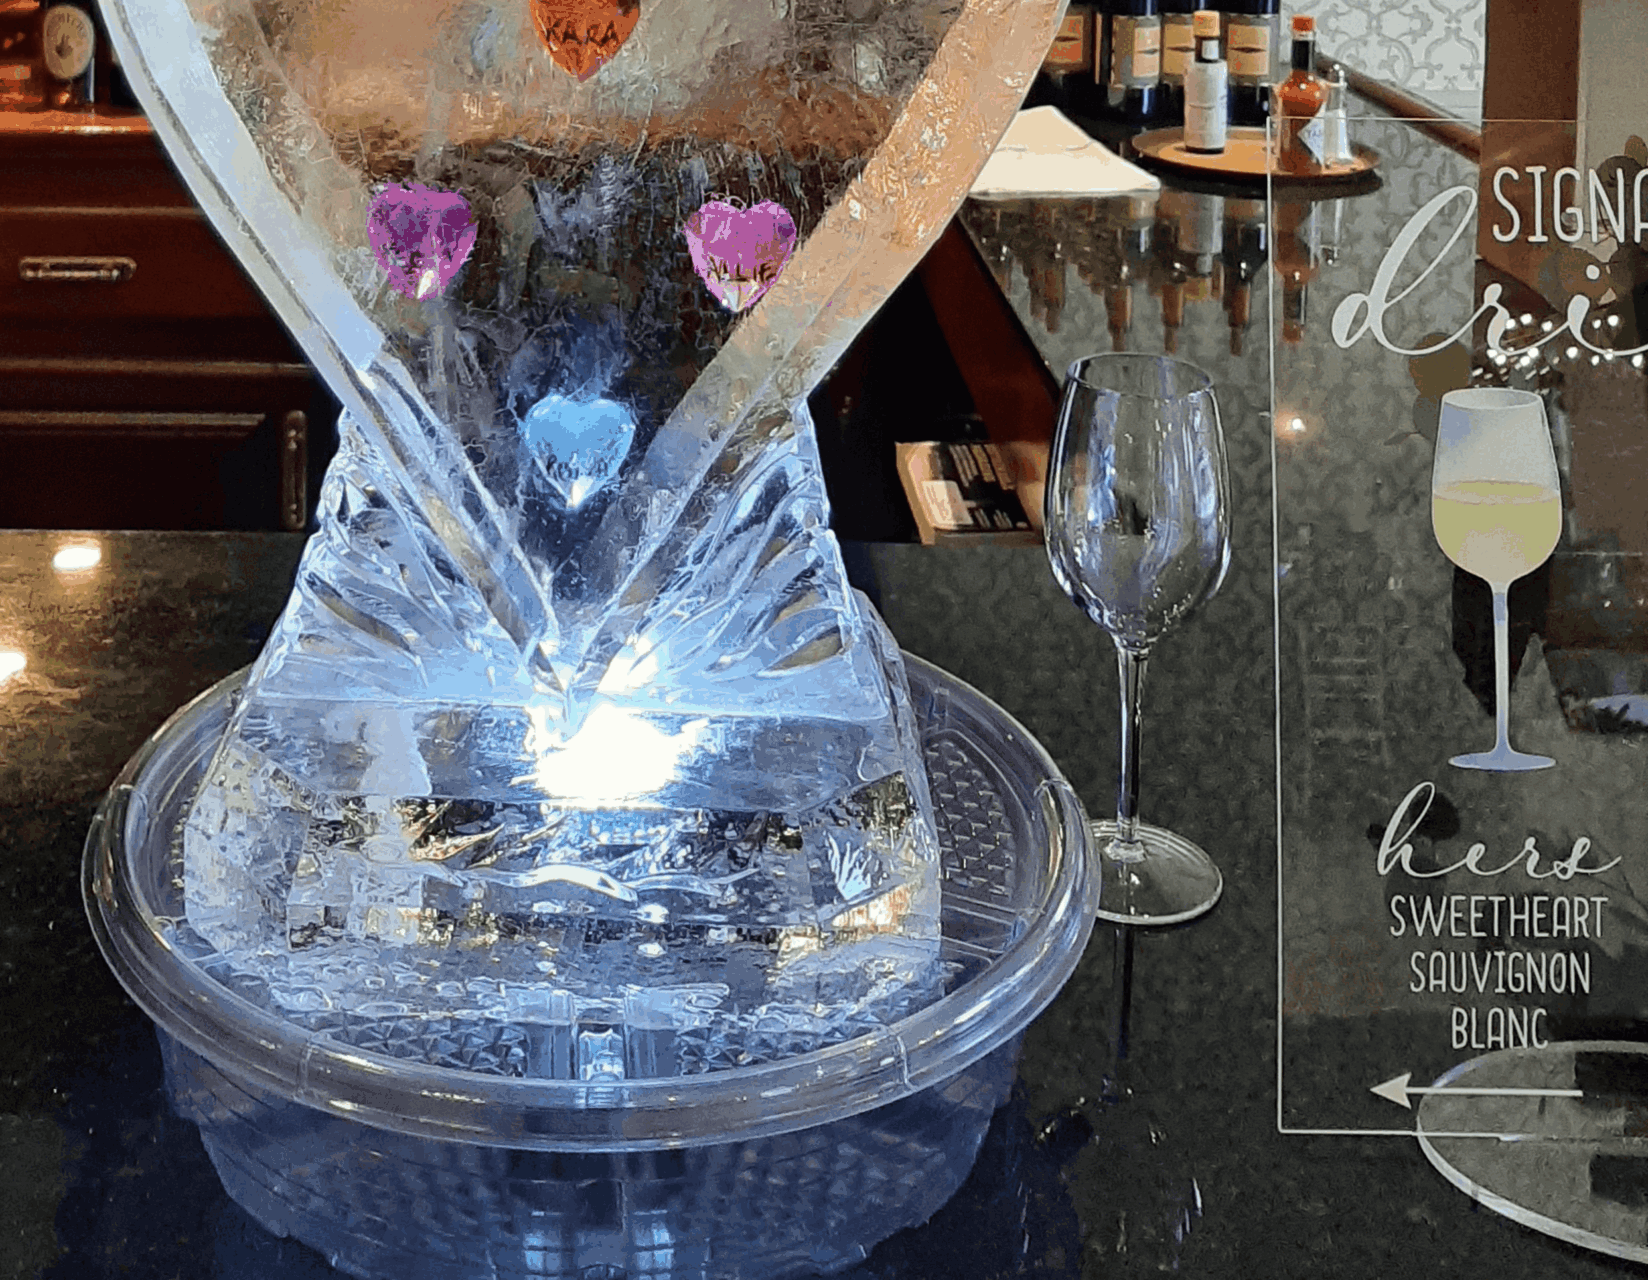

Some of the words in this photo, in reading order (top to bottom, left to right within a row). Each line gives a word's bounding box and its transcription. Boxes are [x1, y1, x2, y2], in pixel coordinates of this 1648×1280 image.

[1377, 781, 1622, 880] hers
[1390, 894, 1609, 938] SWEETHEART
[1410, 950, 1591, 994] SAUVIGNON
[1451, 1006, 1549, 1050] BLANC
